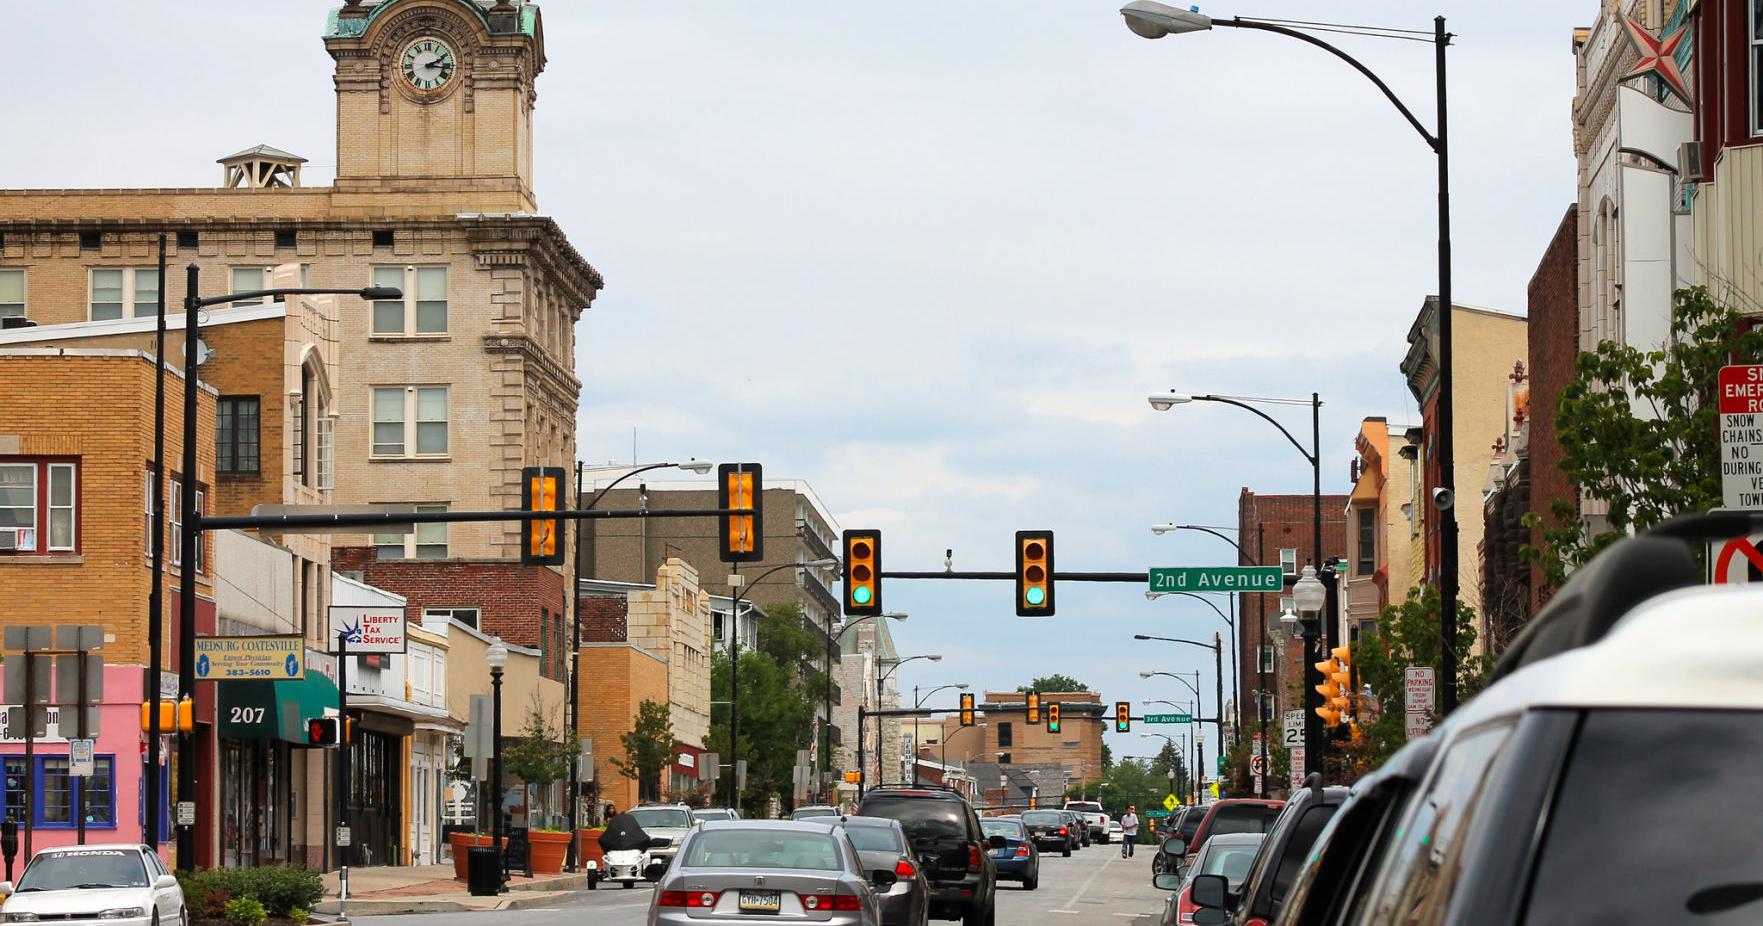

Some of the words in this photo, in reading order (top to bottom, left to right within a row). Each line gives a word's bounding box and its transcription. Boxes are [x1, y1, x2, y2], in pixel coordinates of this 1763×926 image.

[1726, 414, 1755, 427] SNOW
[1722, 429, 1762, 443] CHAINS
[1731, 446, 1749, 459] NO
[1723, 461, 1762, 475] DURING
[1155, 572, 1187, 587] 2nd
[1198, 573, 1276, 587] Avenue
[363, 614, 399, 624] LIBERTY
[363, 624, 381, 633] TAX
[196, 640, 239, 651] MEDSURG
[241, 640, 299, 651] COATESVILLE
[363, 635, 400, 644] SERVICE
[230, 706, 265, 724] 207
[1415, 717, 1425, 725] NO
